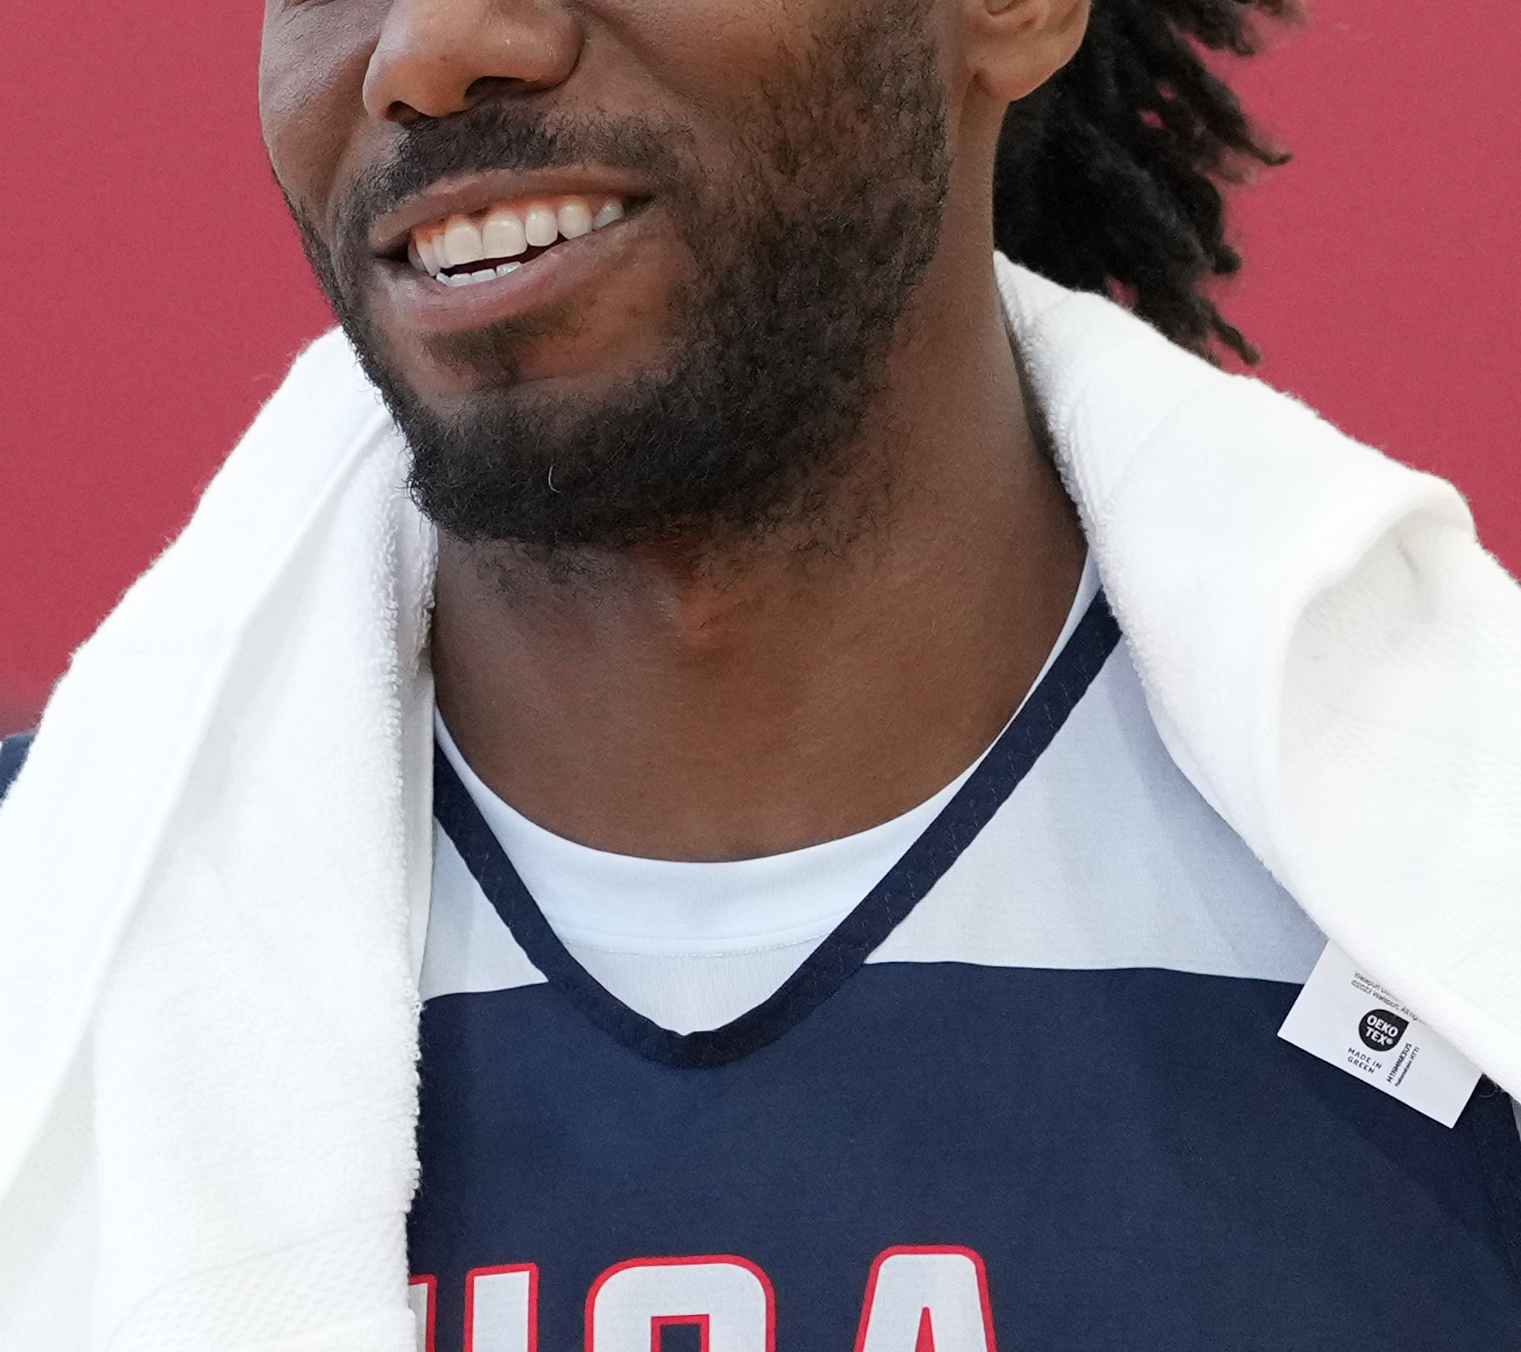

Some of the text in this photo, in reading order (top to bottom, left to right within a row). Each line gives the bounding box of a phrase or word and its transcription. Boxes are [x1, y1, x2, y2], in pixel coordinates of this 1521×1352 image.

[1366, 1015, 1399, 1037] OEKO
[1347, 1056, 1376, 1074] GREEN
[1348, 1047, 1383, 1070] MADE IN
